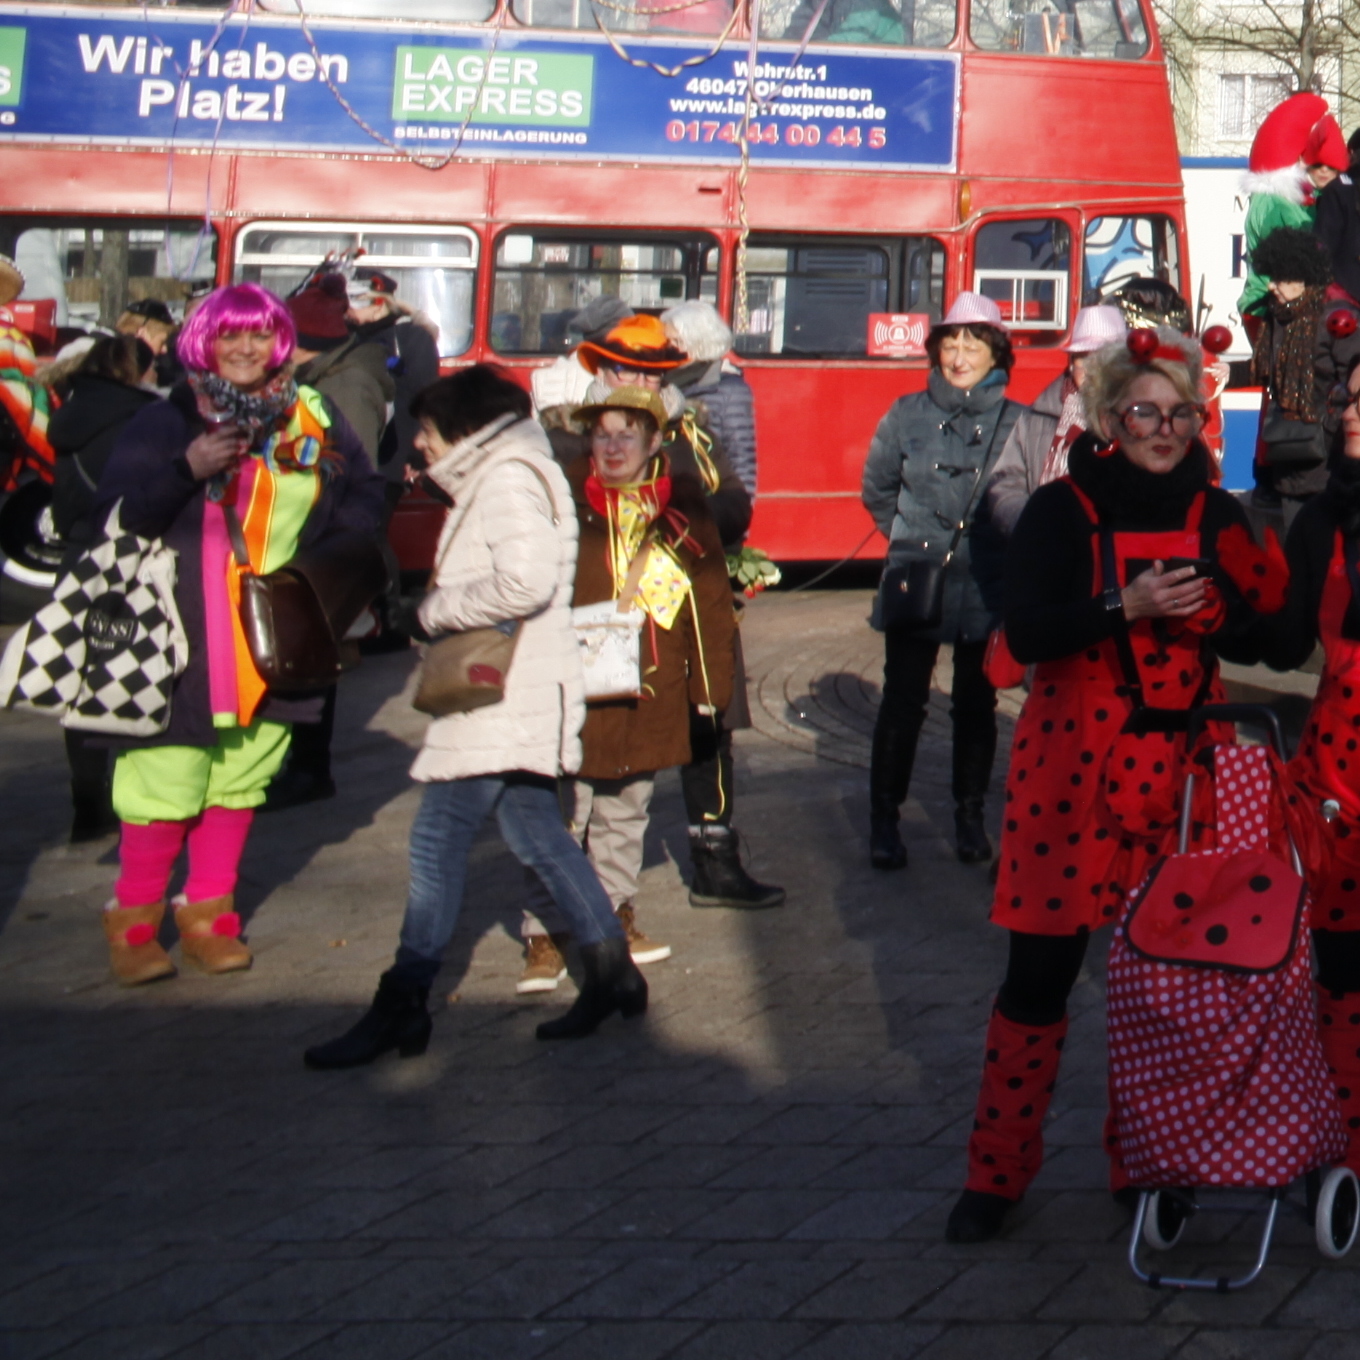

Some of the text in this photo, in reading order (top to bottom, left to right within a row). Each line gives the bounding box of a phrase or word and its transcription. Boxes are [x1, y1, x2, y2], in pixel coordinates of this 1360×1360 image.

[78, 33, 349, 83] Wir haben
[403, 52, 539, 86] LAGER
[138, 79, 288, 122] Platz!
[401, 83, 584, 118] EXPRESS
[685, 77, 748, 96] 46047
[669, 98, 887, 120] www.lagrexpress.de
[393, 126, 589, 145] SELBSTEINLAGERUNG
[665, 119, 887, 149] 0174 44 00 44 5
